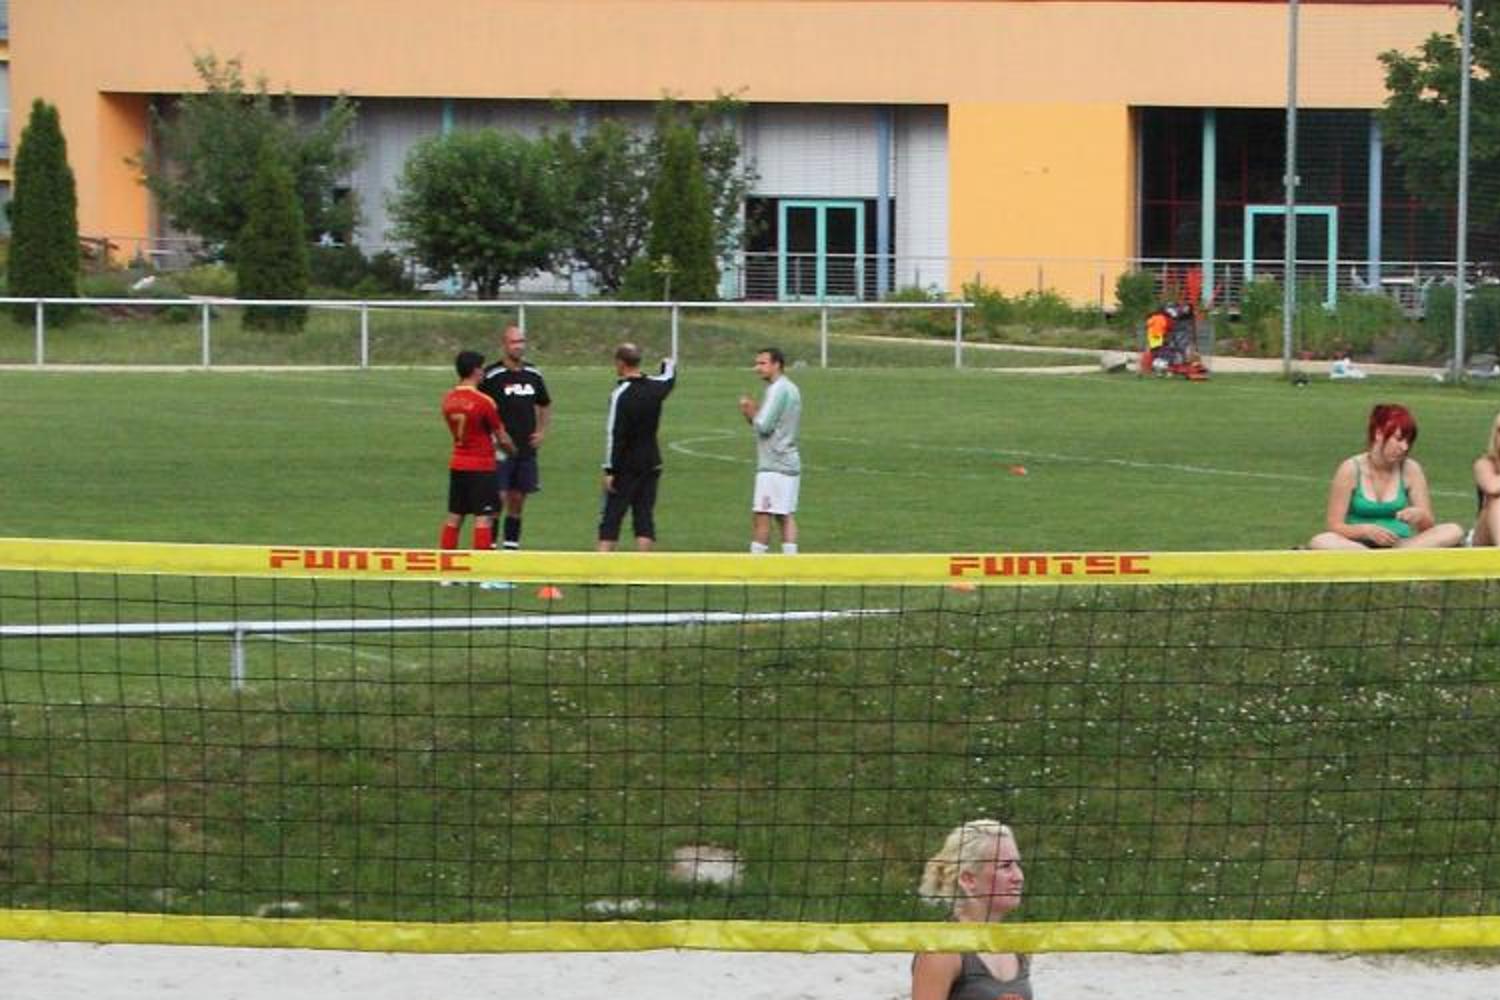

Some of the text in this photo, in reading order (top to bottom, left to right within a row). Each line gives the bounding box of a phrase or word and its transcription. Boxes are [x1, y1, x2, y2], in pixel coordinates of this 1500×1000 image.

[450, 413, 466, 446] 7
[270, 549, 471, 571] FUNTEC
[950, 555, 1150, 576] FUNTEC
